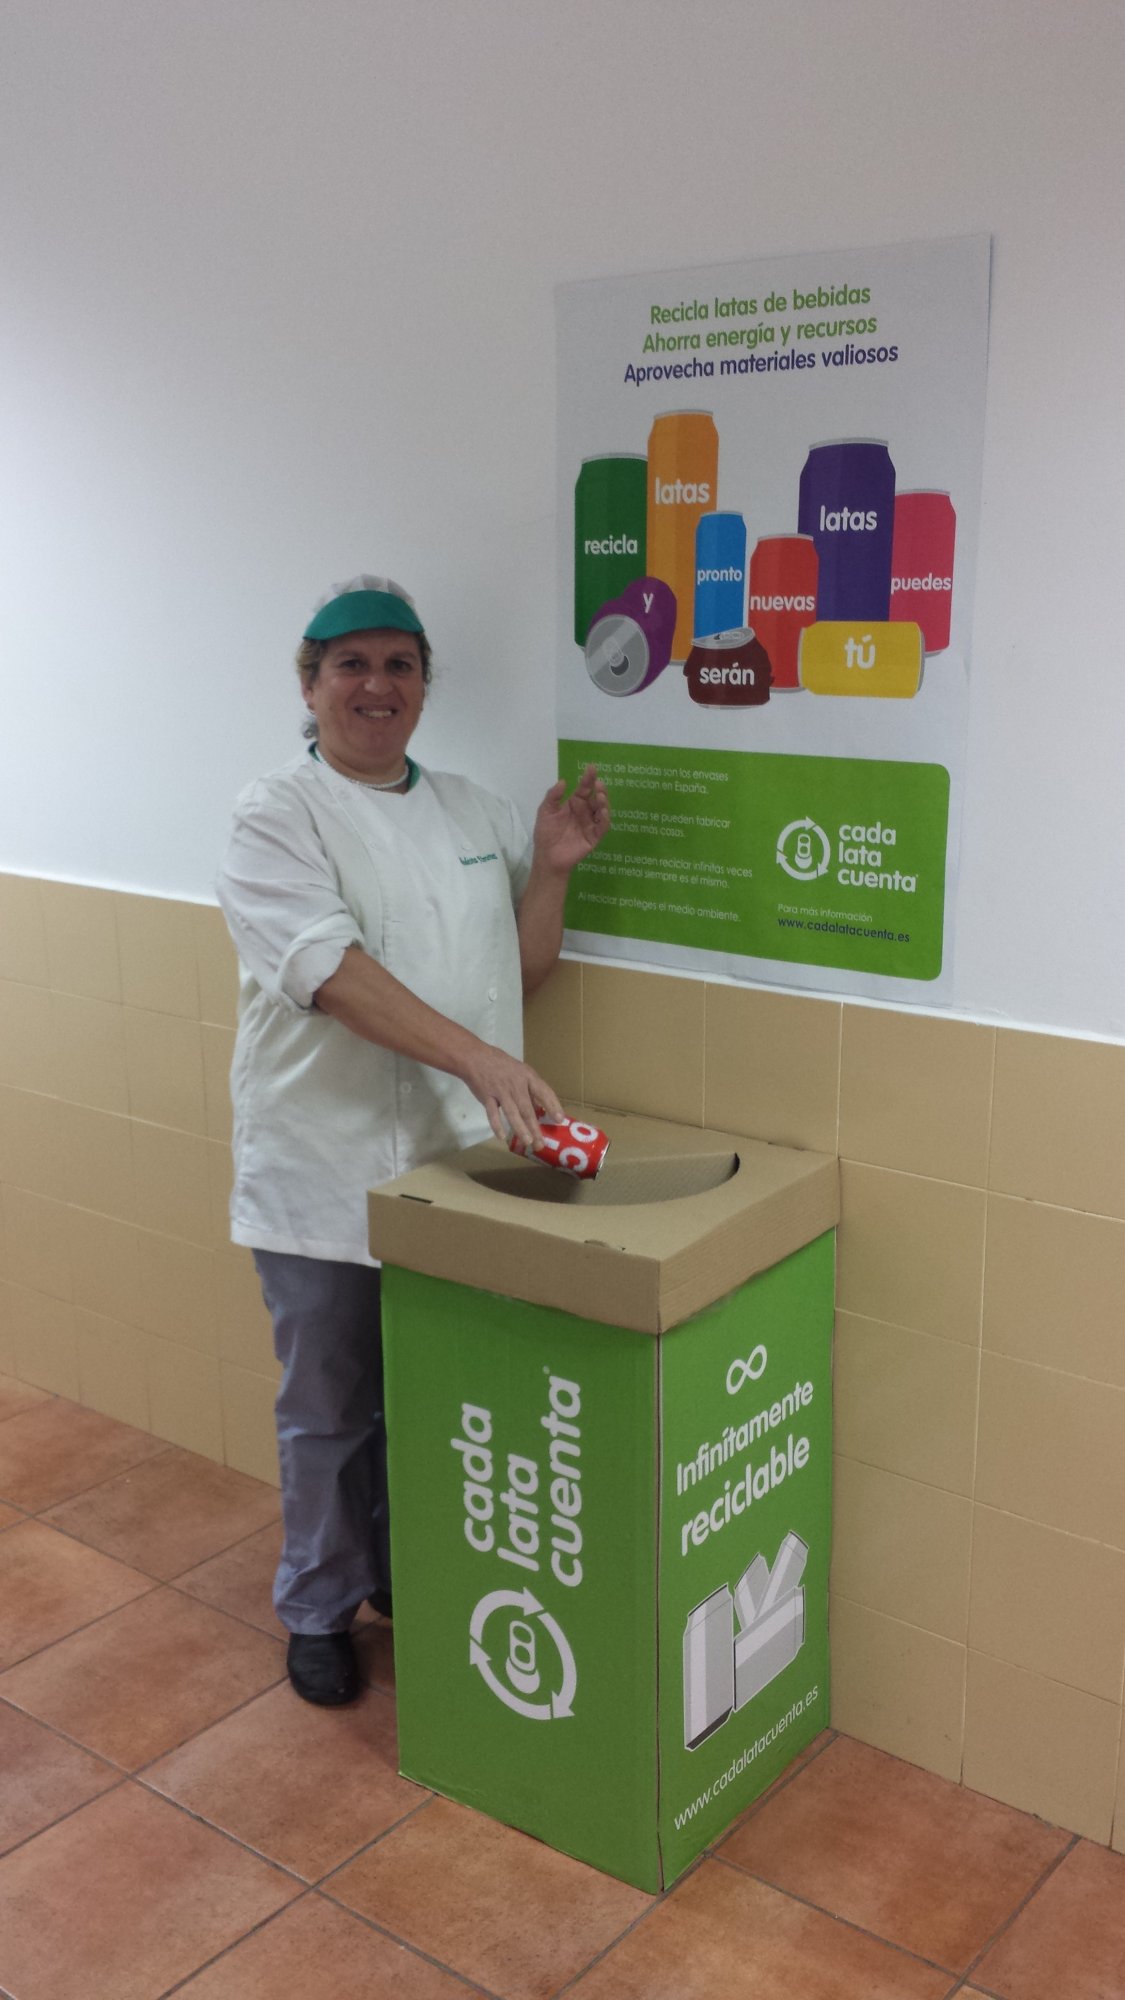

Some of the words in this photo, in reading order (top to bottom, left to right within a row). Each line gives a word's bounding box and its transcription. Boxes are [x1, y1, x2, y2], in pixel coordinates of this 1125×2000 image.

[650, 300, 708, 324] Recicla
[714, 297, 758, 318] latas
[763, 292, 787, 313] de
[793, 284, 871, 311] bebidas
[642, 332, 700, 354] Ahorra
[706, 322, 774, 349] energía
[780, 325, 791, 346] y
[797, 317, 878, 340] recursos
[624, 357, 714, 387] Aprovecha
[720, 349, 816, 376] materiales
[821, 344, 899, 368] valiosos
[655, 477, 710, 504] latas
[819, 505, 878, 532] latas
[584, 534, 638, 555] recicla
[697, 566, 743, 586] pronto
[890, 572, 952, 595] puedes
[643, 592, 654, 614] y
[750, 595, 816, 612] nuevas
[844, 634, 877, 669] tú
[700, 662, 755, 686] serán
[838, 821, 897, 845] cada
[838, 841, 882, 867] lata
[837, 868, 917, 893] cuenta
[778, 903, 798, 914] Para
[799, 906, 818, 916] más
[820, 907, 873, 922] información
[778, 917, 911, 943] www.cadalatacuenta.es
[450, 1402, 495, 1553] cada
[540, 1374, 584, 1588] cuenta
[681, 1433, 810, 1557] reciclable
[496, 1453, 540, 1572] lata
[673, 1685, 819, 1831] www.cadalatacuenta.es
